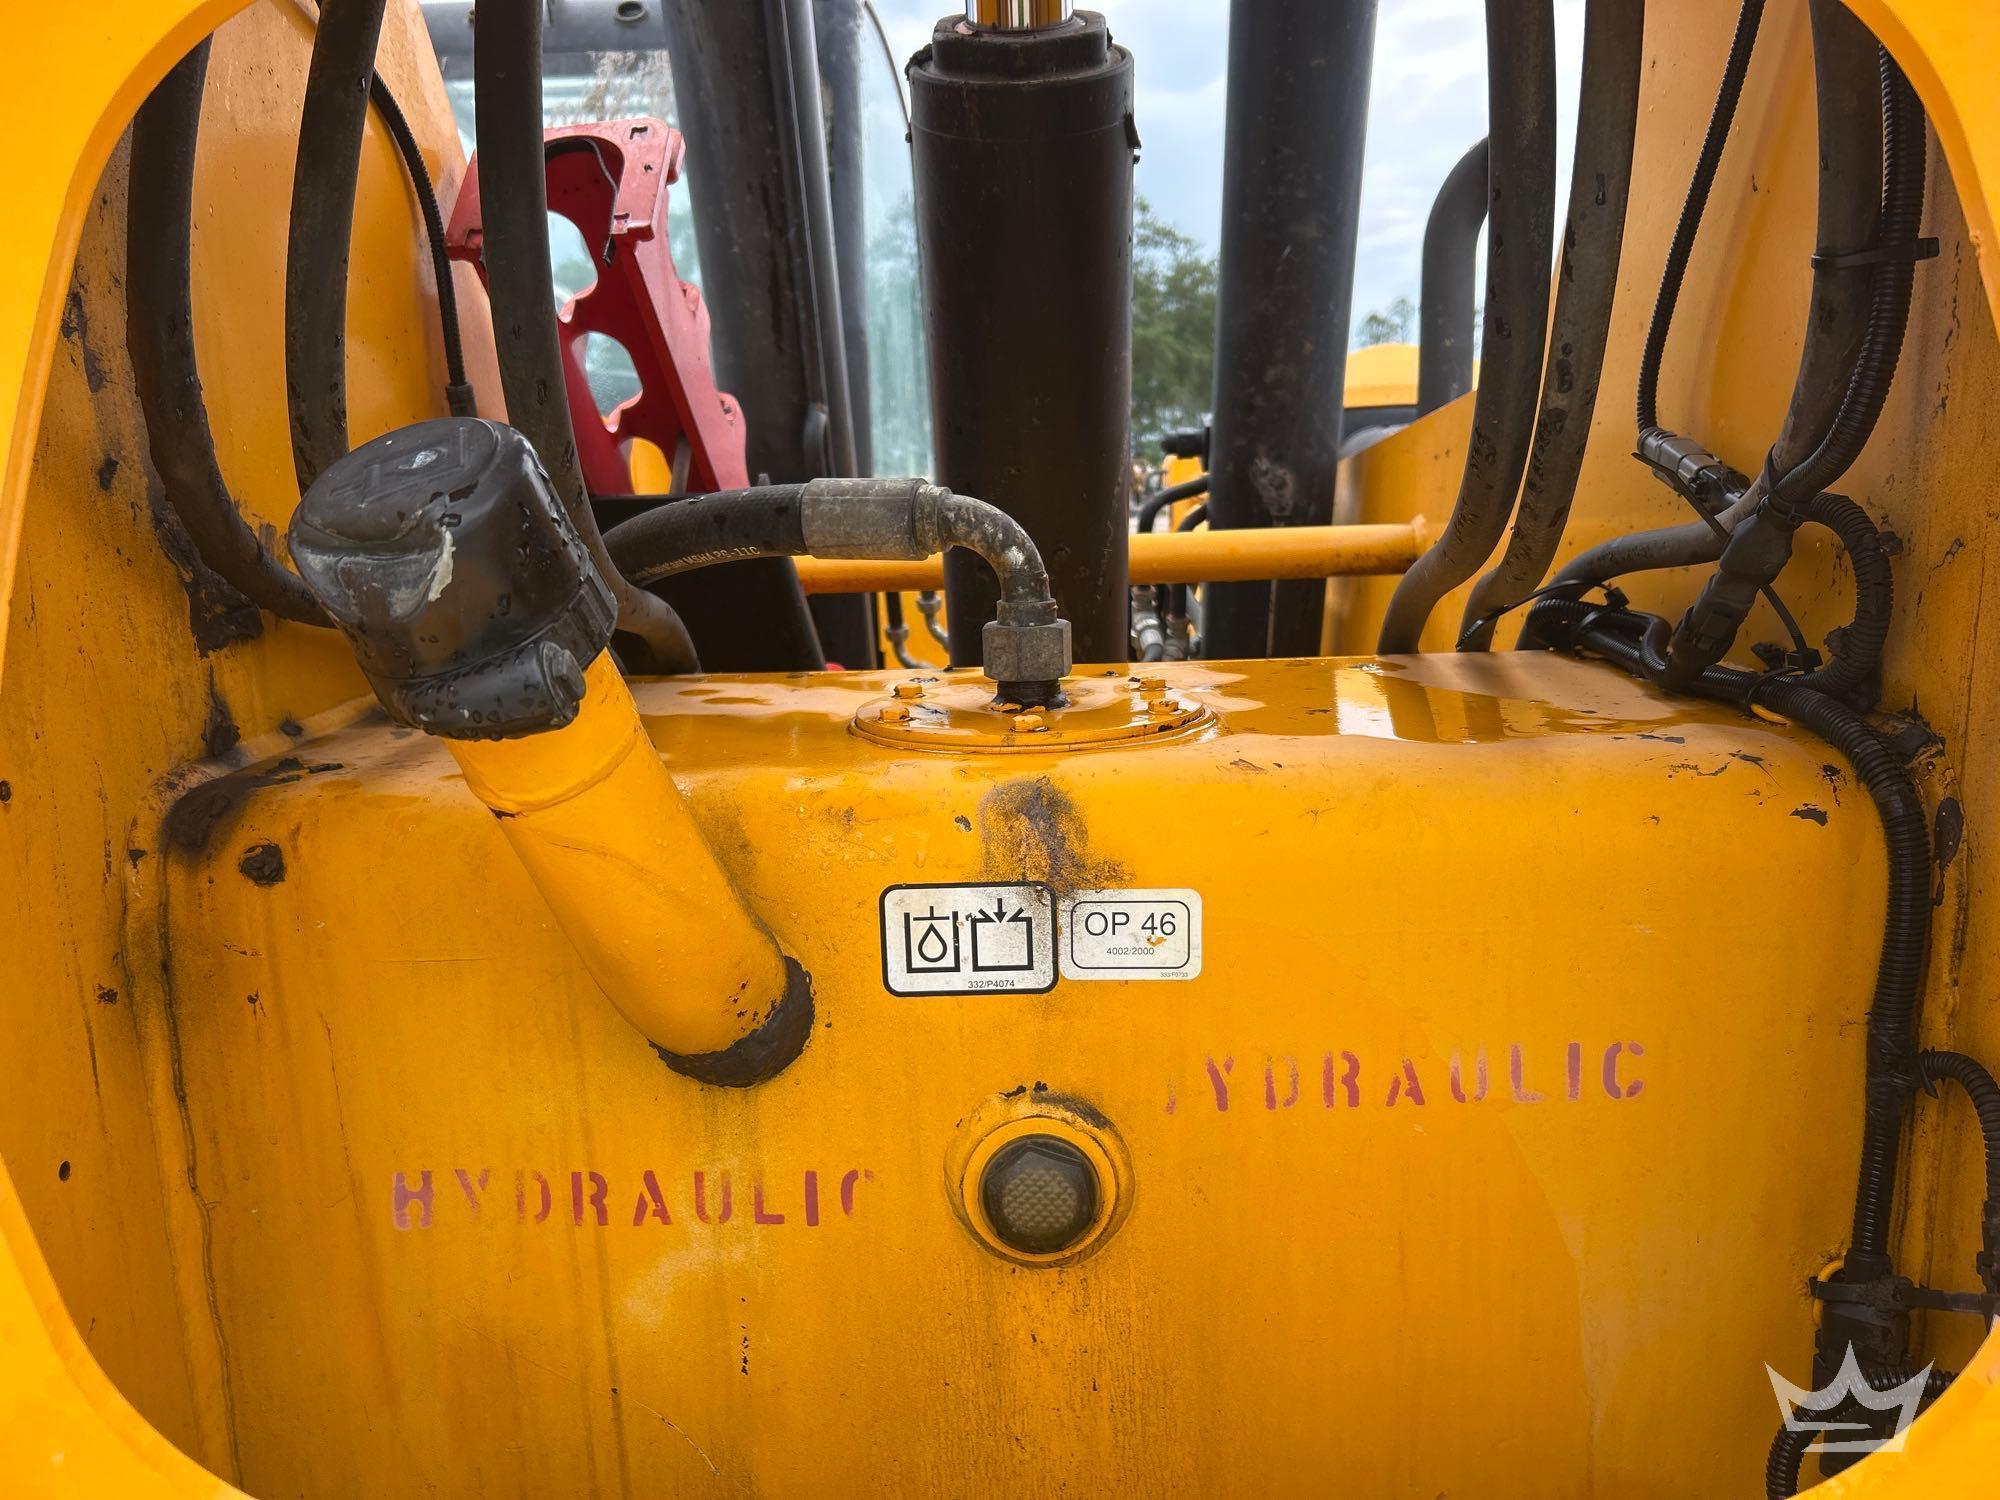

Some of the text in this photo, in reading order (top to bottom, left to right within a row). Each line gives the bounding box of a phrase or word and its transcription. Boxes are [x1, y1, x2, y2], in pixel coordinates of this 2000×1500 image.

[682, 552, 715, 566] MSHA
[1084, 911, 1176, 936] OP 46
[1106, 947, 1155, 956] 4002/2000
[967, 980, 1015, 989] 332/P4074
